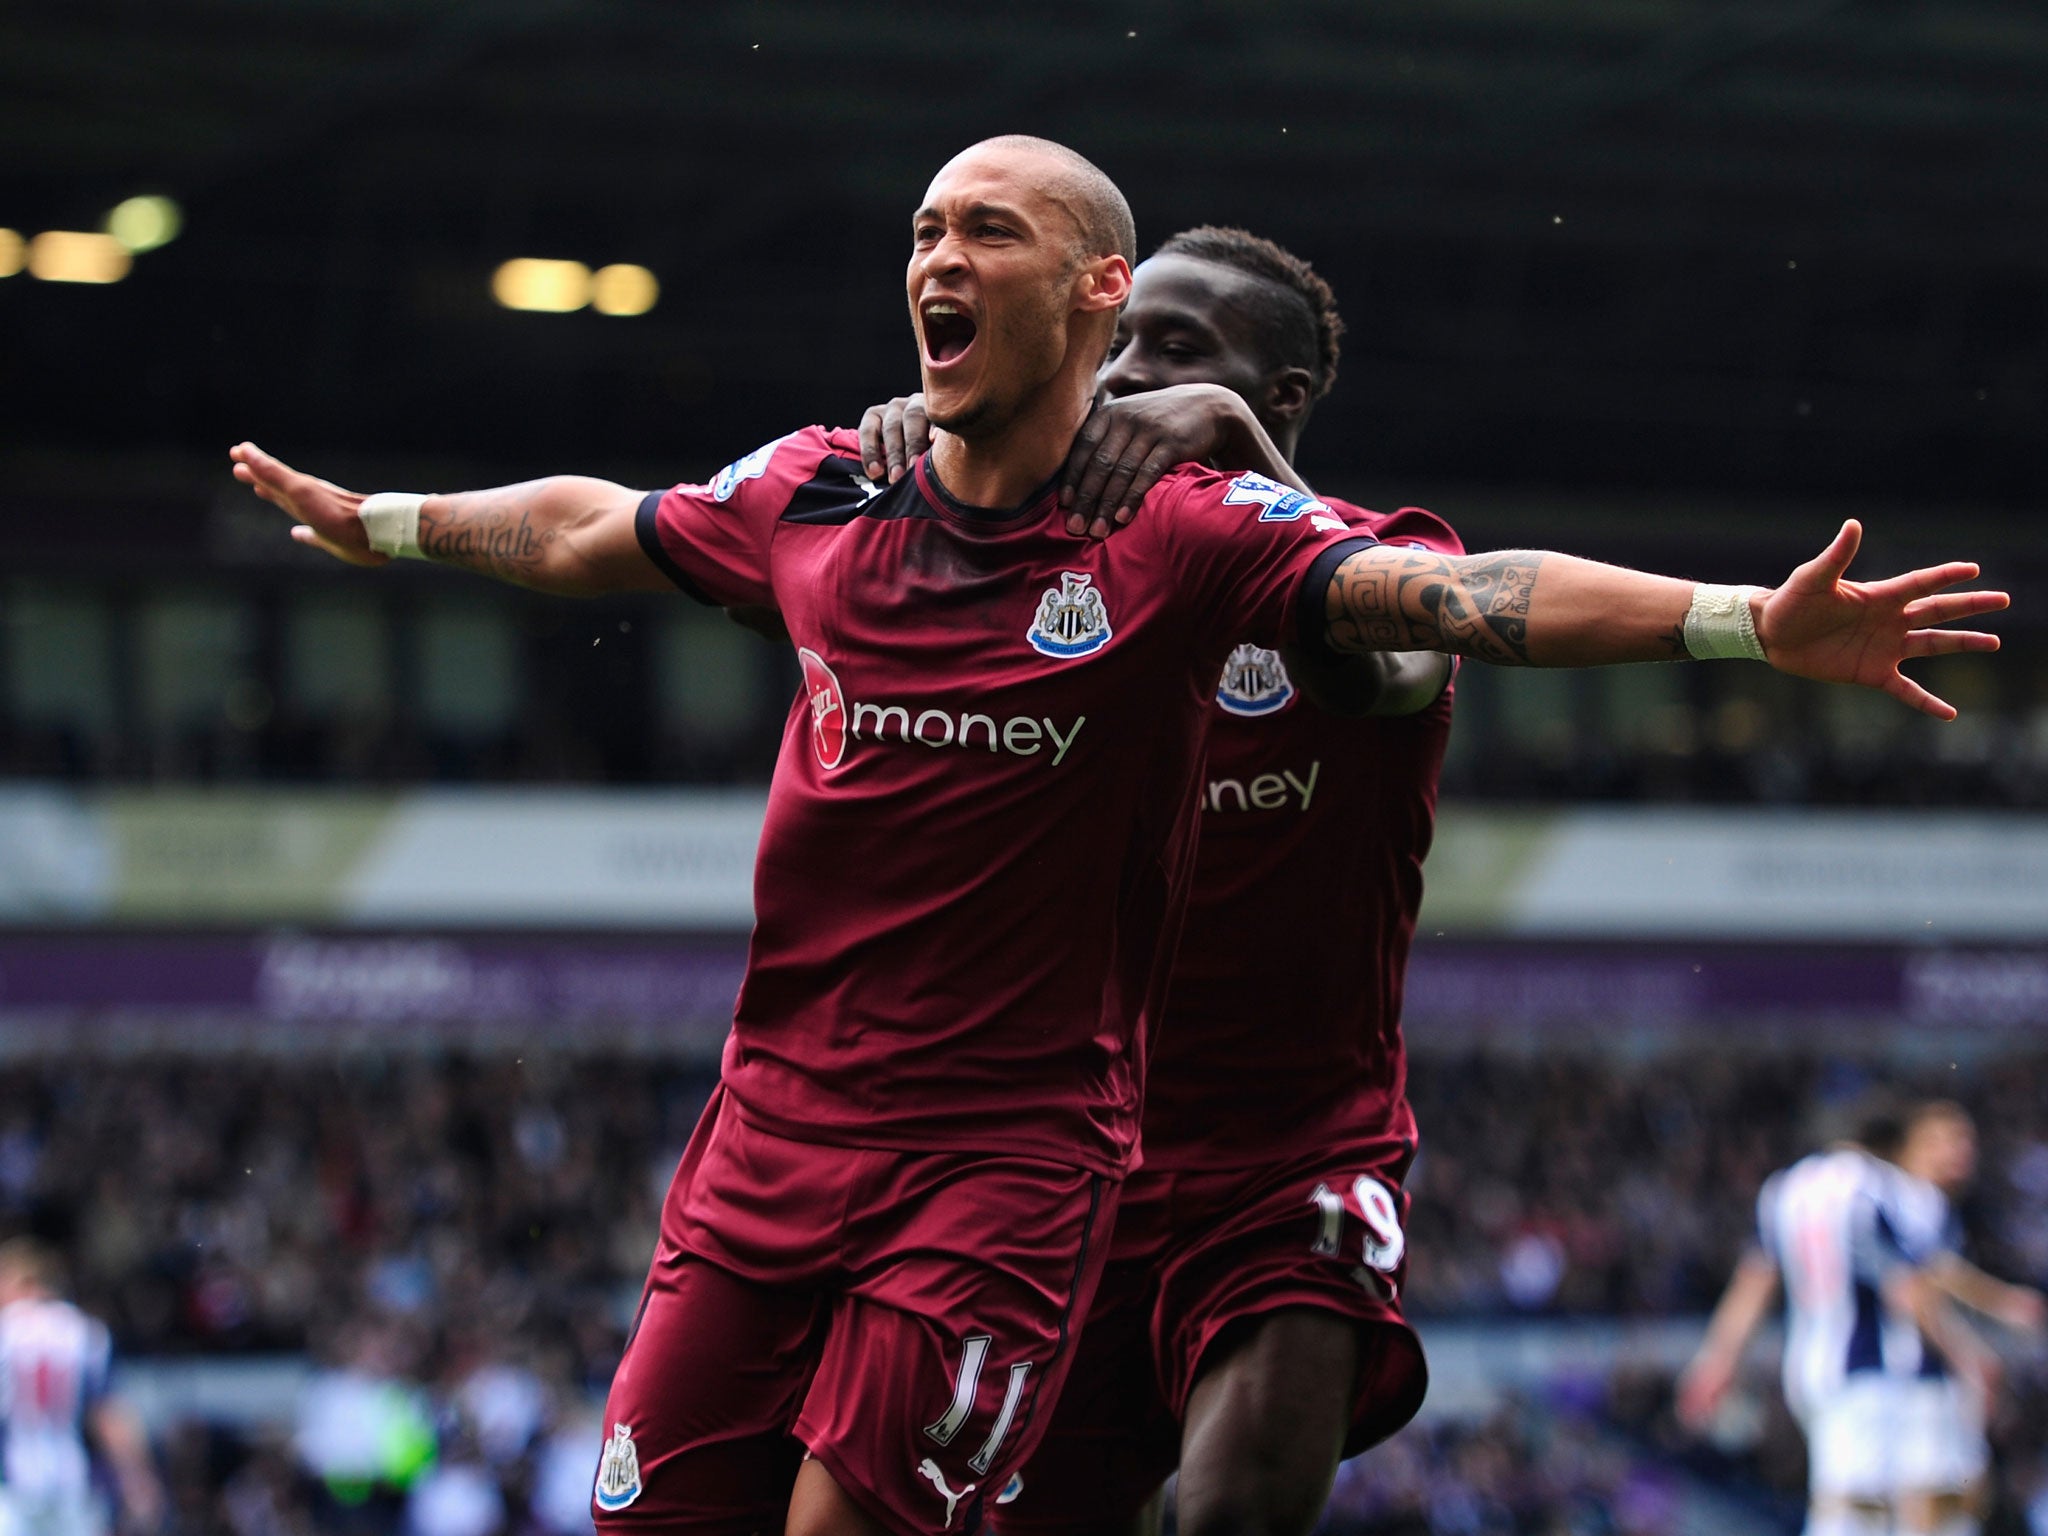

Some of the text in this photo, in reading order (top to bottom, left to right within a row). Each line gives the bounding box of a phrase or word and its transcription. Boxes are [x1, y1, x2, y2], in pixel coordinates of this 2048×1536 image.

[851, 701, 1086, 766] money
[1202, 760, 1320, 813] ney
[1306, 1173, 1405, 1273] 19
[922, 1335, 1033, 1477] 11
